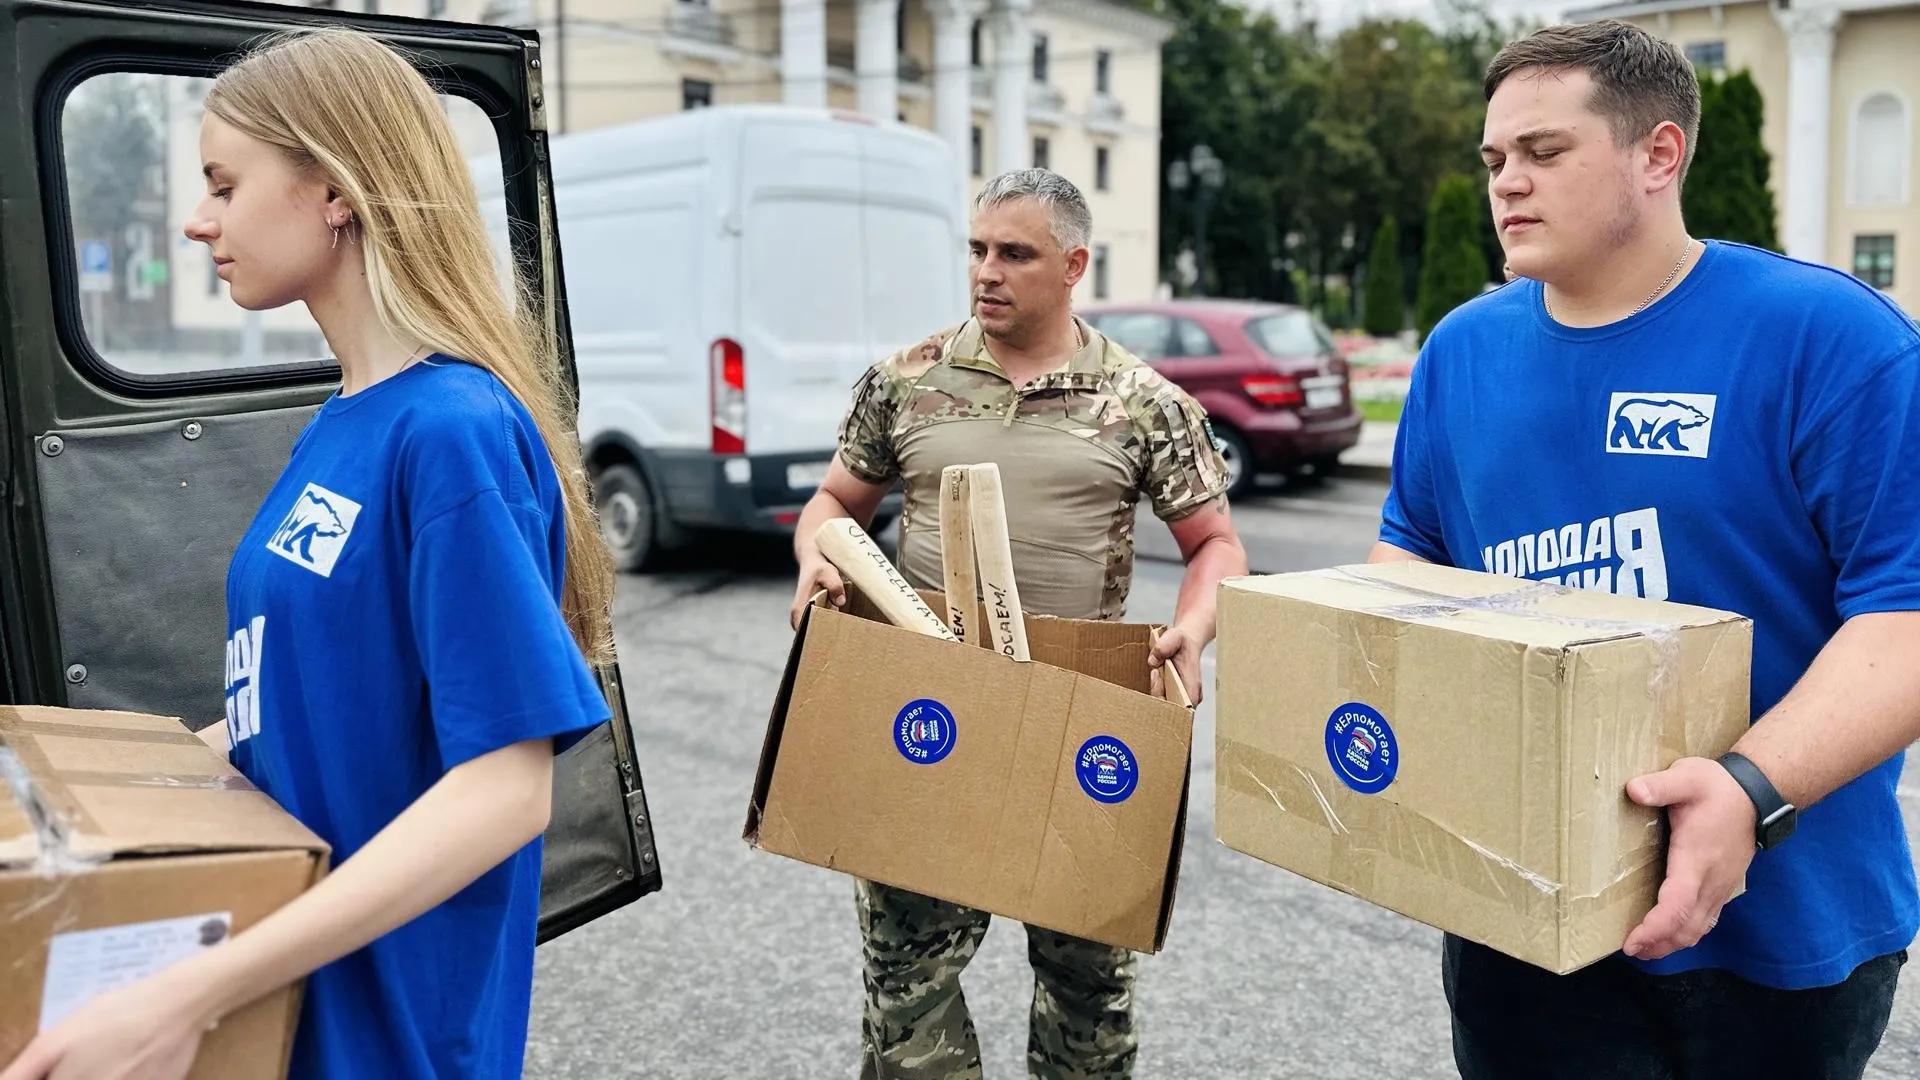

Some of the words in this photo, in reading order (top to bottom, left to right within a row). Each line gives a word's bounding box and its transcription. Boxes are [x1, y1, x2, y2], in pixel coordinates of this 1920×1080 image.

[901, 707, 928, 758] #ЕРпомогает
[1081, 743, 1131, 772] #ЕРпомогает
[1334, 712, 1390, 766] #ЕРпомогает
